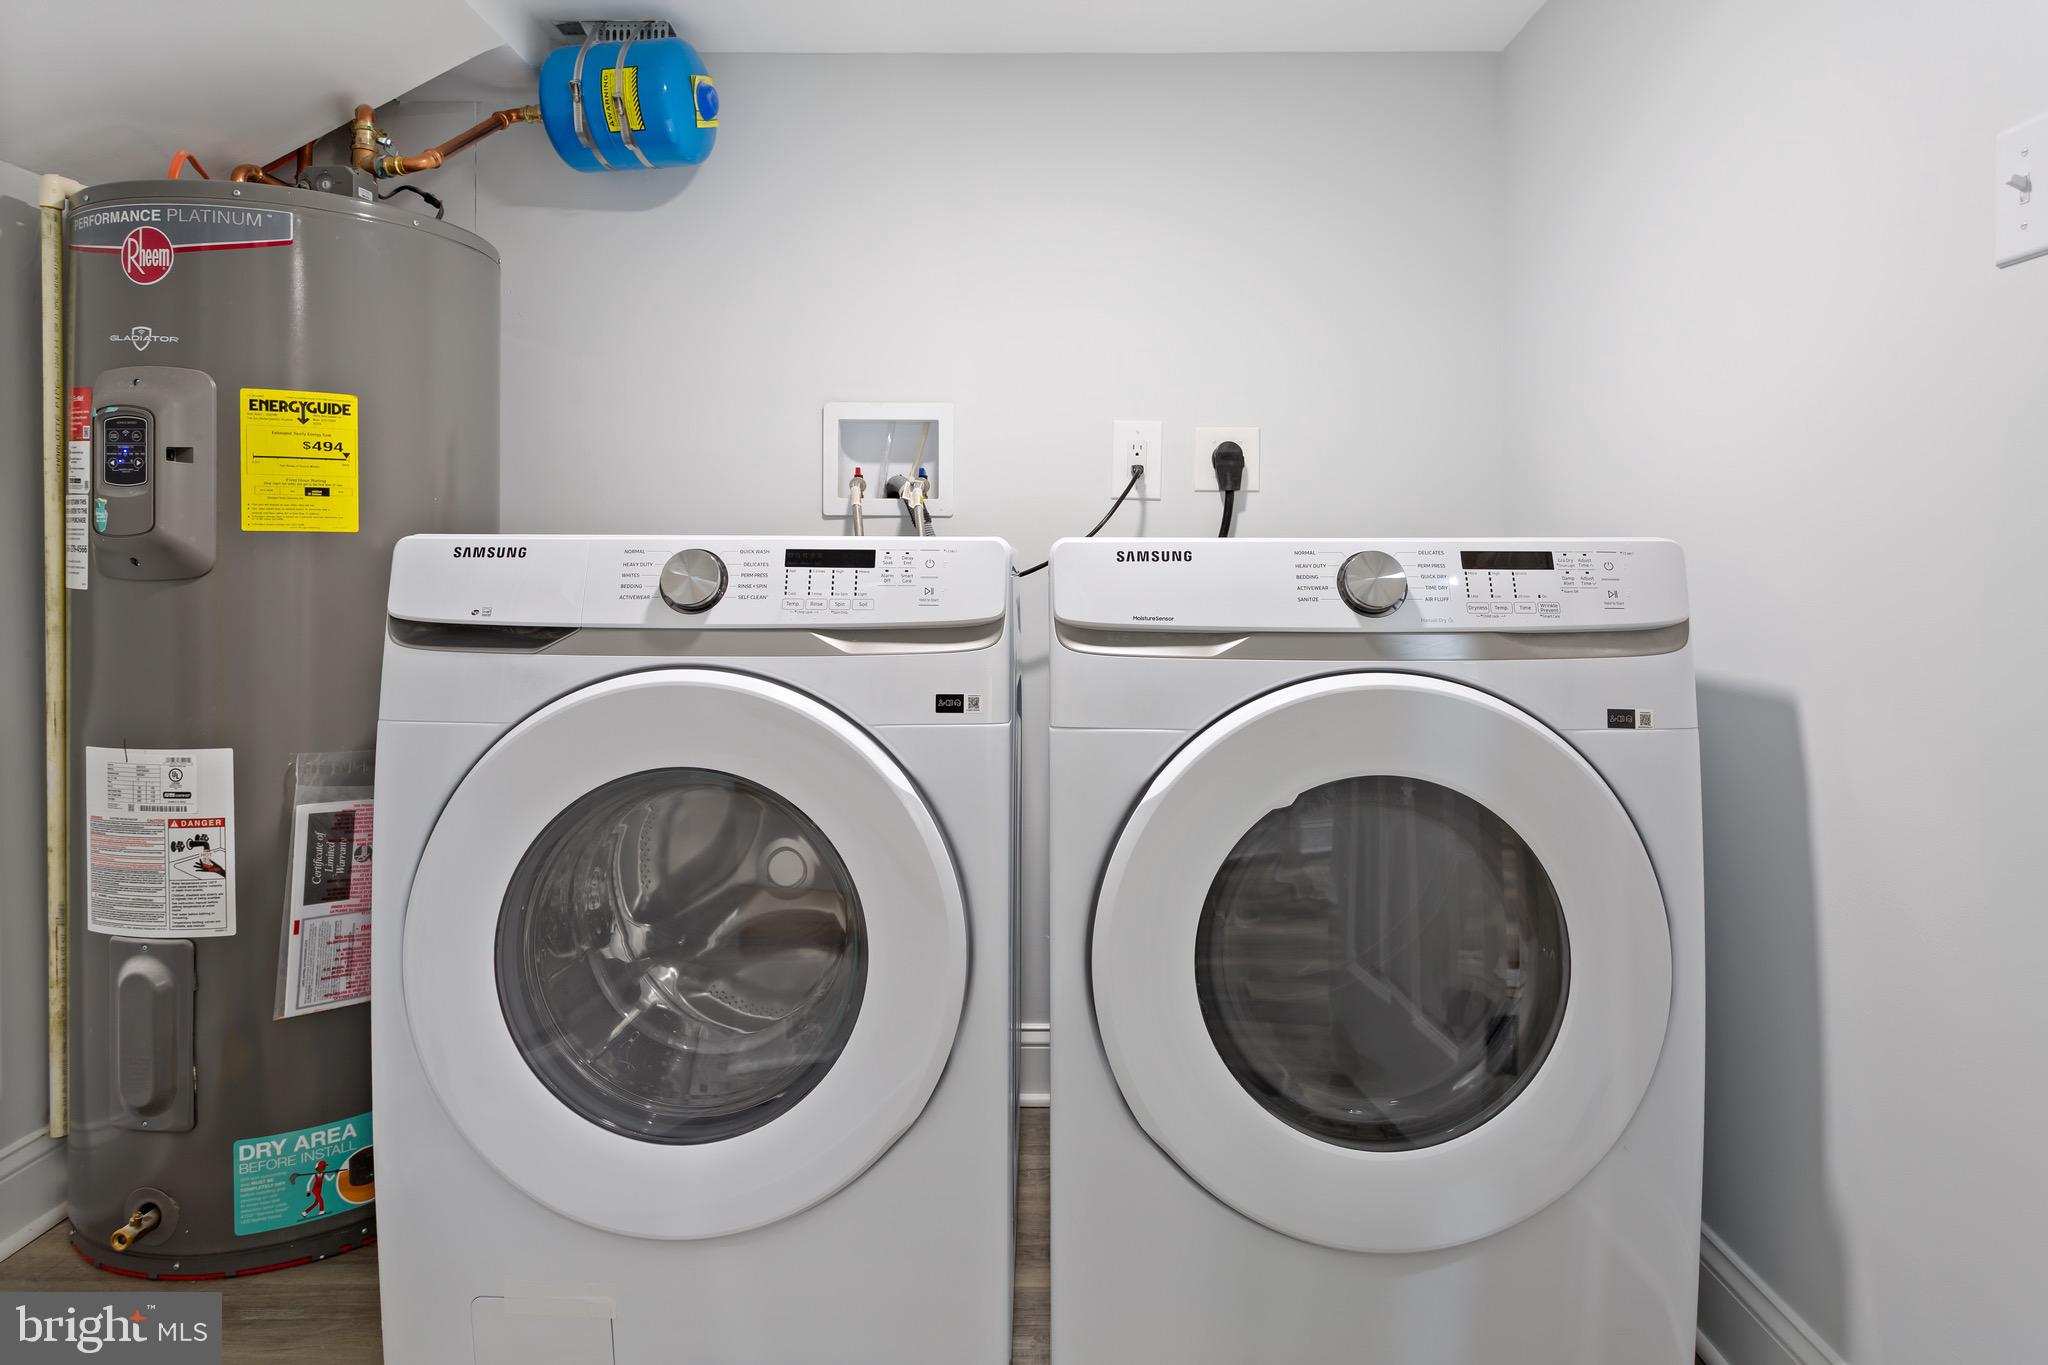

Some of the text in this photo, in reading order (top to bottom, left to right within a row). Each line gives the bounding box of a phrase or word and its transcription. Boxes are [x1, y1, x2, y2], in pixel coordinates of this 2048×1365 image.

[604, 74, 613, 120] WARNING
[74, 208, 262, 230] PERFORMANCE PLATINUM
[127, 227, 170, 274] Rheem
[110, 334, 179, 344] GLADIATOR
[249, 399, 352, 418] ENERGYGUIDE
[302, 441, 343, 452] $494
[453, 547, 527, 558] SAMSUNG
[1116, 551, 1192, 562] SAMSUNG
[312, 831, 326, 884] Certificate of
[325, 842, 335, 872] Limited
[239, 1123, 357, 1162] DRY AREA
[239, 1141, 357, 1175] BEFORE INSTALL
